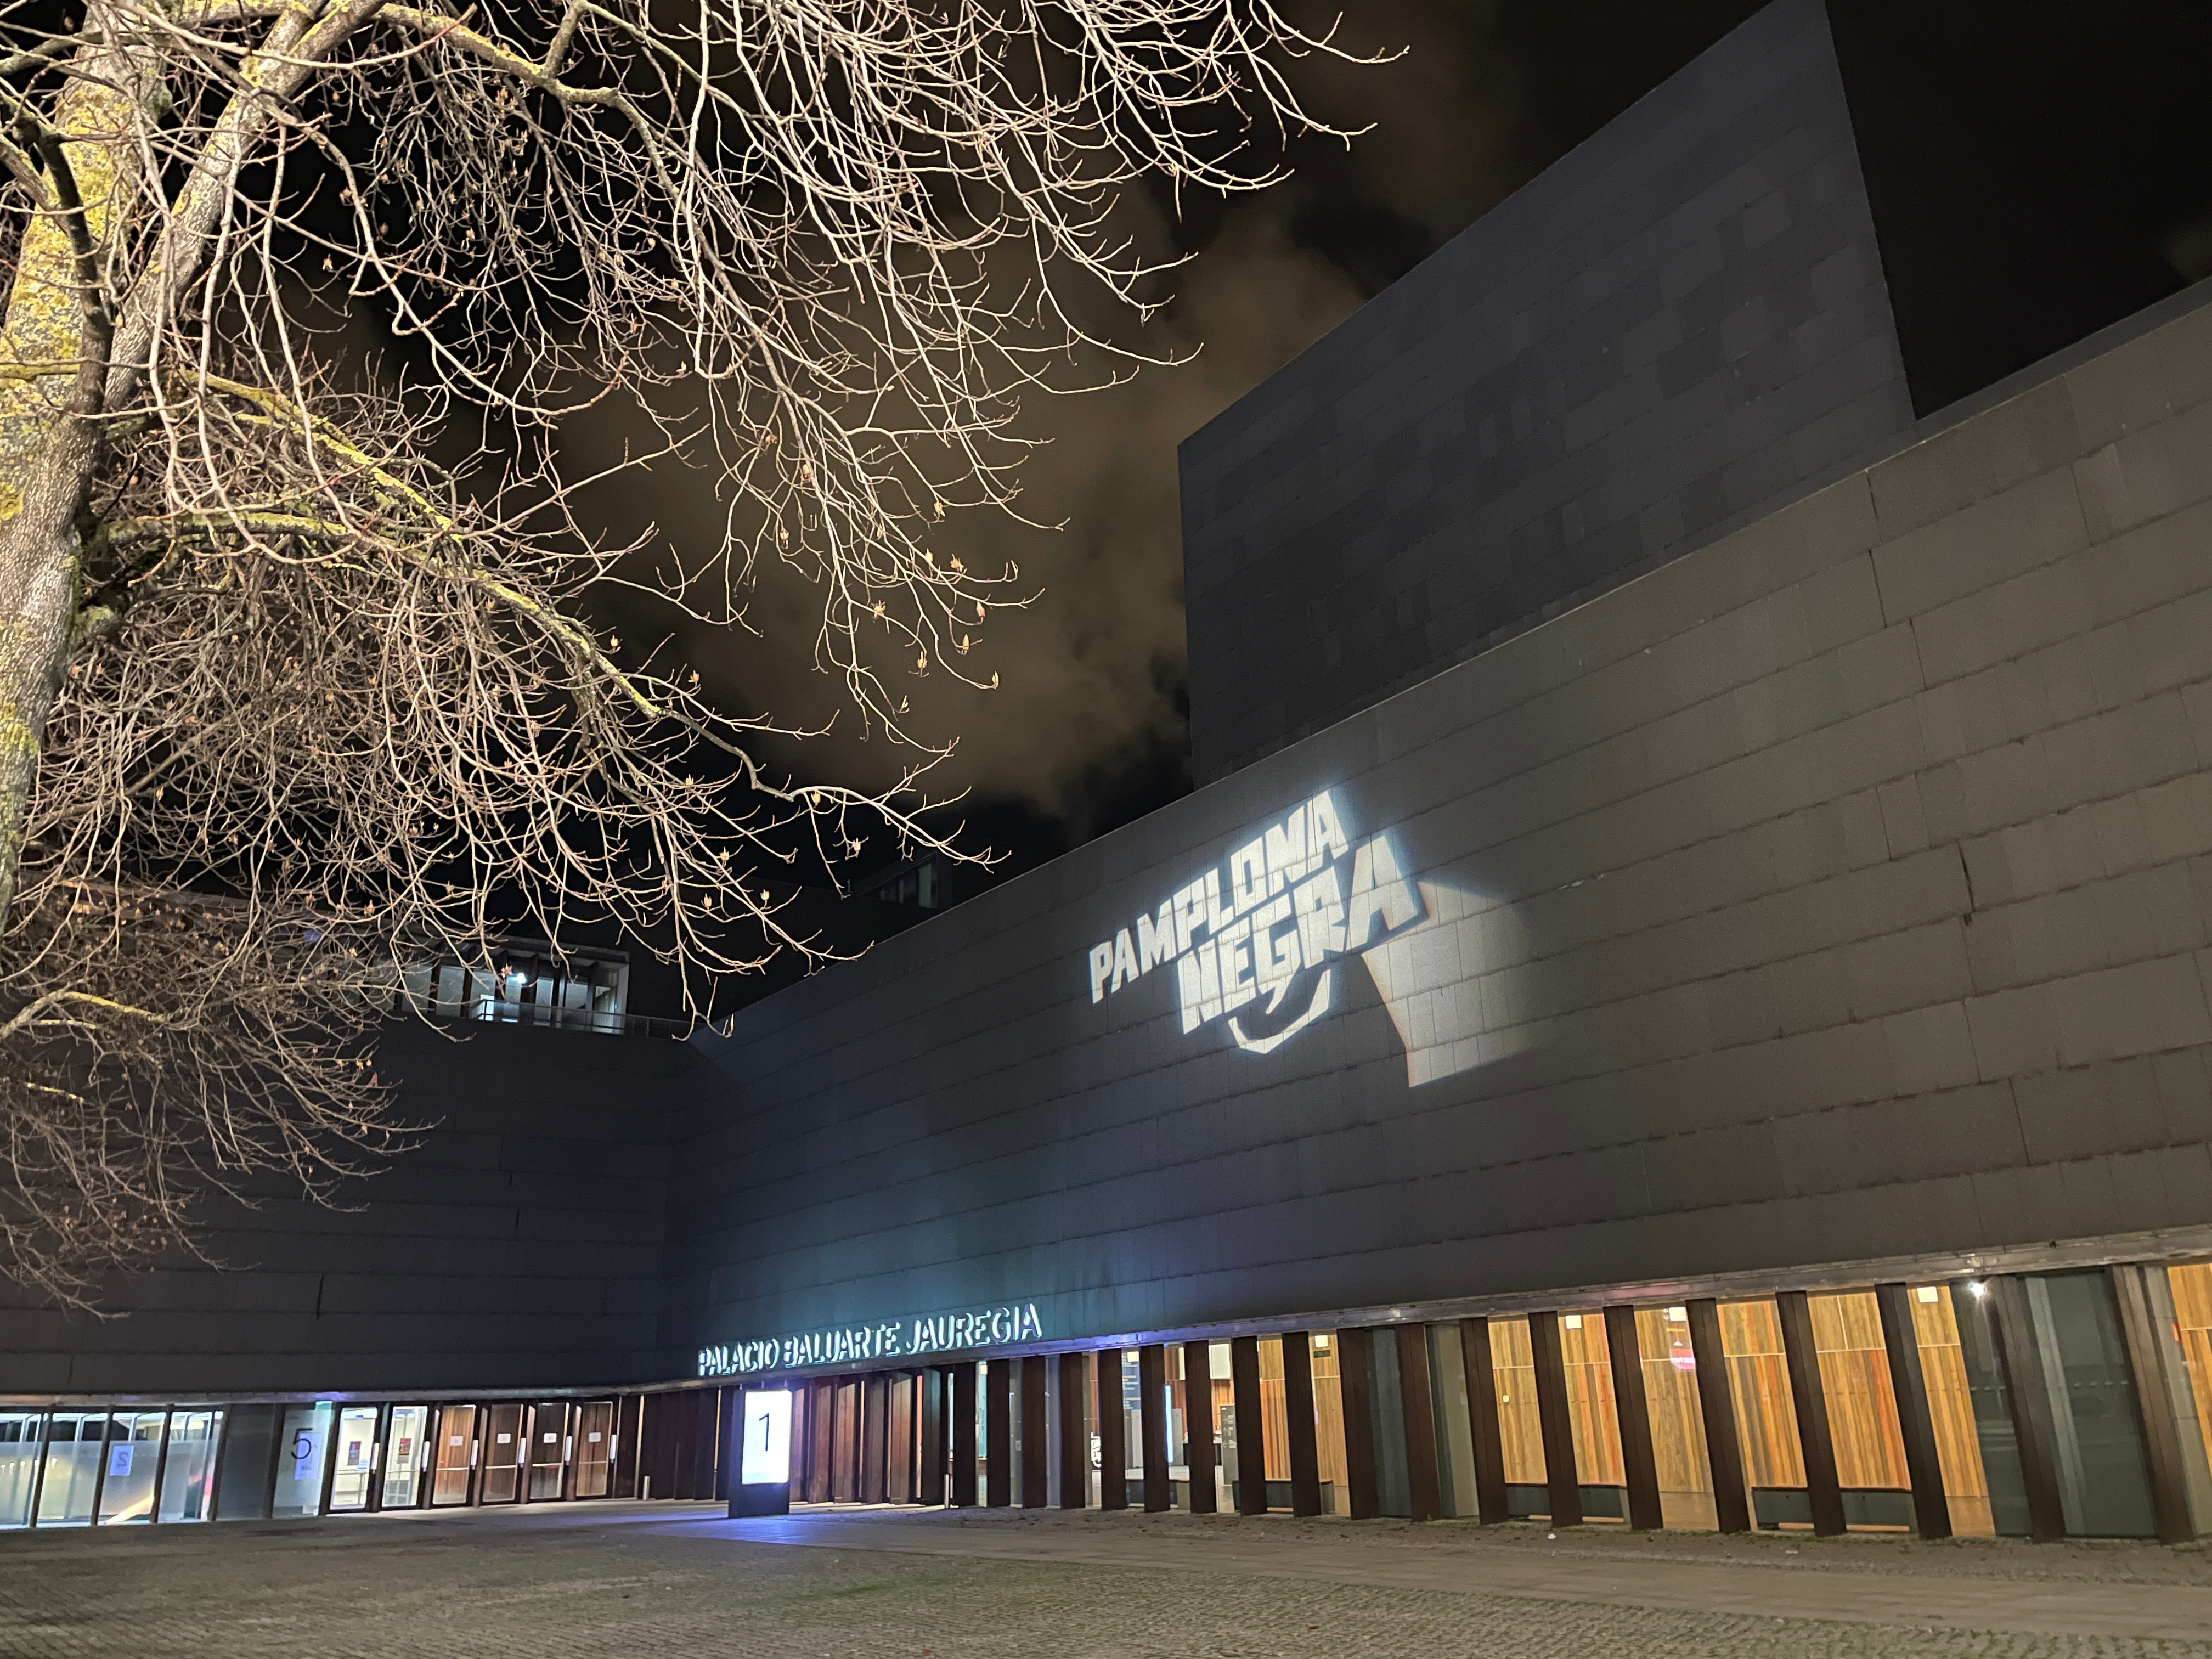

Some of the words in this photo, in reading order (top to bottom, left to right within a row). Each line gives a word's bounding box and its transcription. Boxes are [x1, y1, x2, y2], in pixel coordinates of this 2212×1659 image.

[1089, 790, 1348, 1004] PAMPLONA
[1177, 836, 1418, 1035] NEGRA
[698, 1338, 780, 1376] PALACIO
[783, 1322, 901, 1368] BALUARTE
[906, 1304, 1042, 1355] JAUREGIA
[291, 1428, 313, 1459] 5
[759, 1412, 769, 1452] 1
